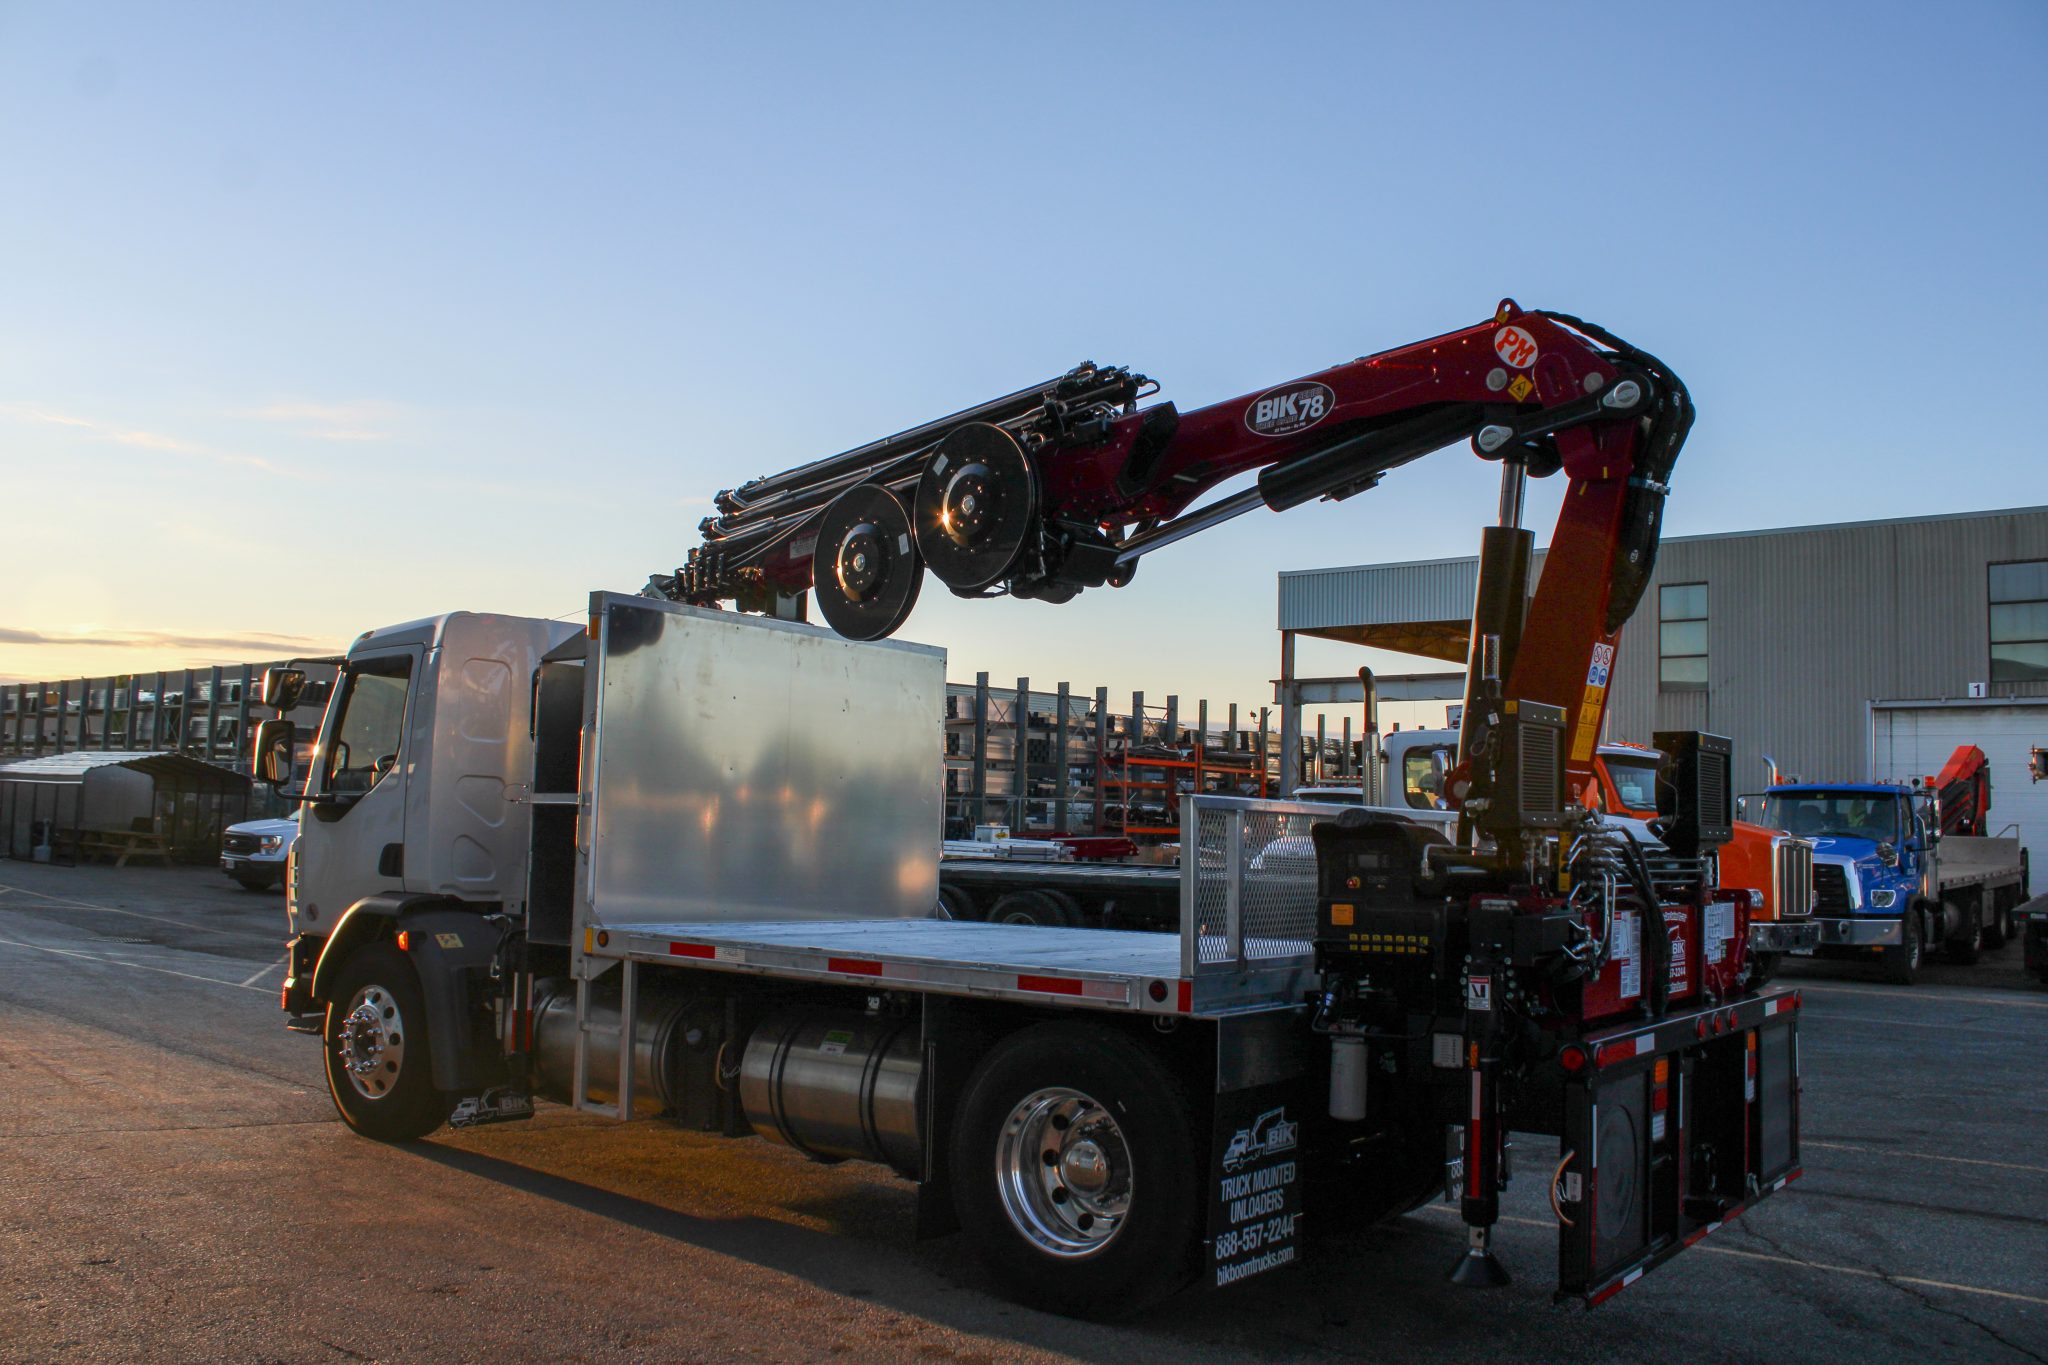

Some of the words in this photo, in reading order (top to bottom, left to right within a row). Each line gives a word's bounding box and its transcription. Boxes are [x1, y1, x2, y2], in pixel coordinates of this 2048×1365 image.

[1496, 328, 1536, 367] PM
[1255, 392, 1299, 424] BIK
[1299, 395, 1324, 421] 78
[1973, 684, 1980, 697] 1
[1672, 942, 1685, 954] BIK
[502, 1096, 529, 1110] BIK
[1268, 1126, 1295, 1147] BIK
[1221, 1171, 1251, 1202] TRUCK
[1252, 1162, 1296, 1193] MOUNTED
[1230, 1188, 1284, 1224] UNLOADERS
[1216, 1215, 1294, 1260] 888-557-2244
[1217, 1246, 1294, 1287] bikboomtrucks.com
